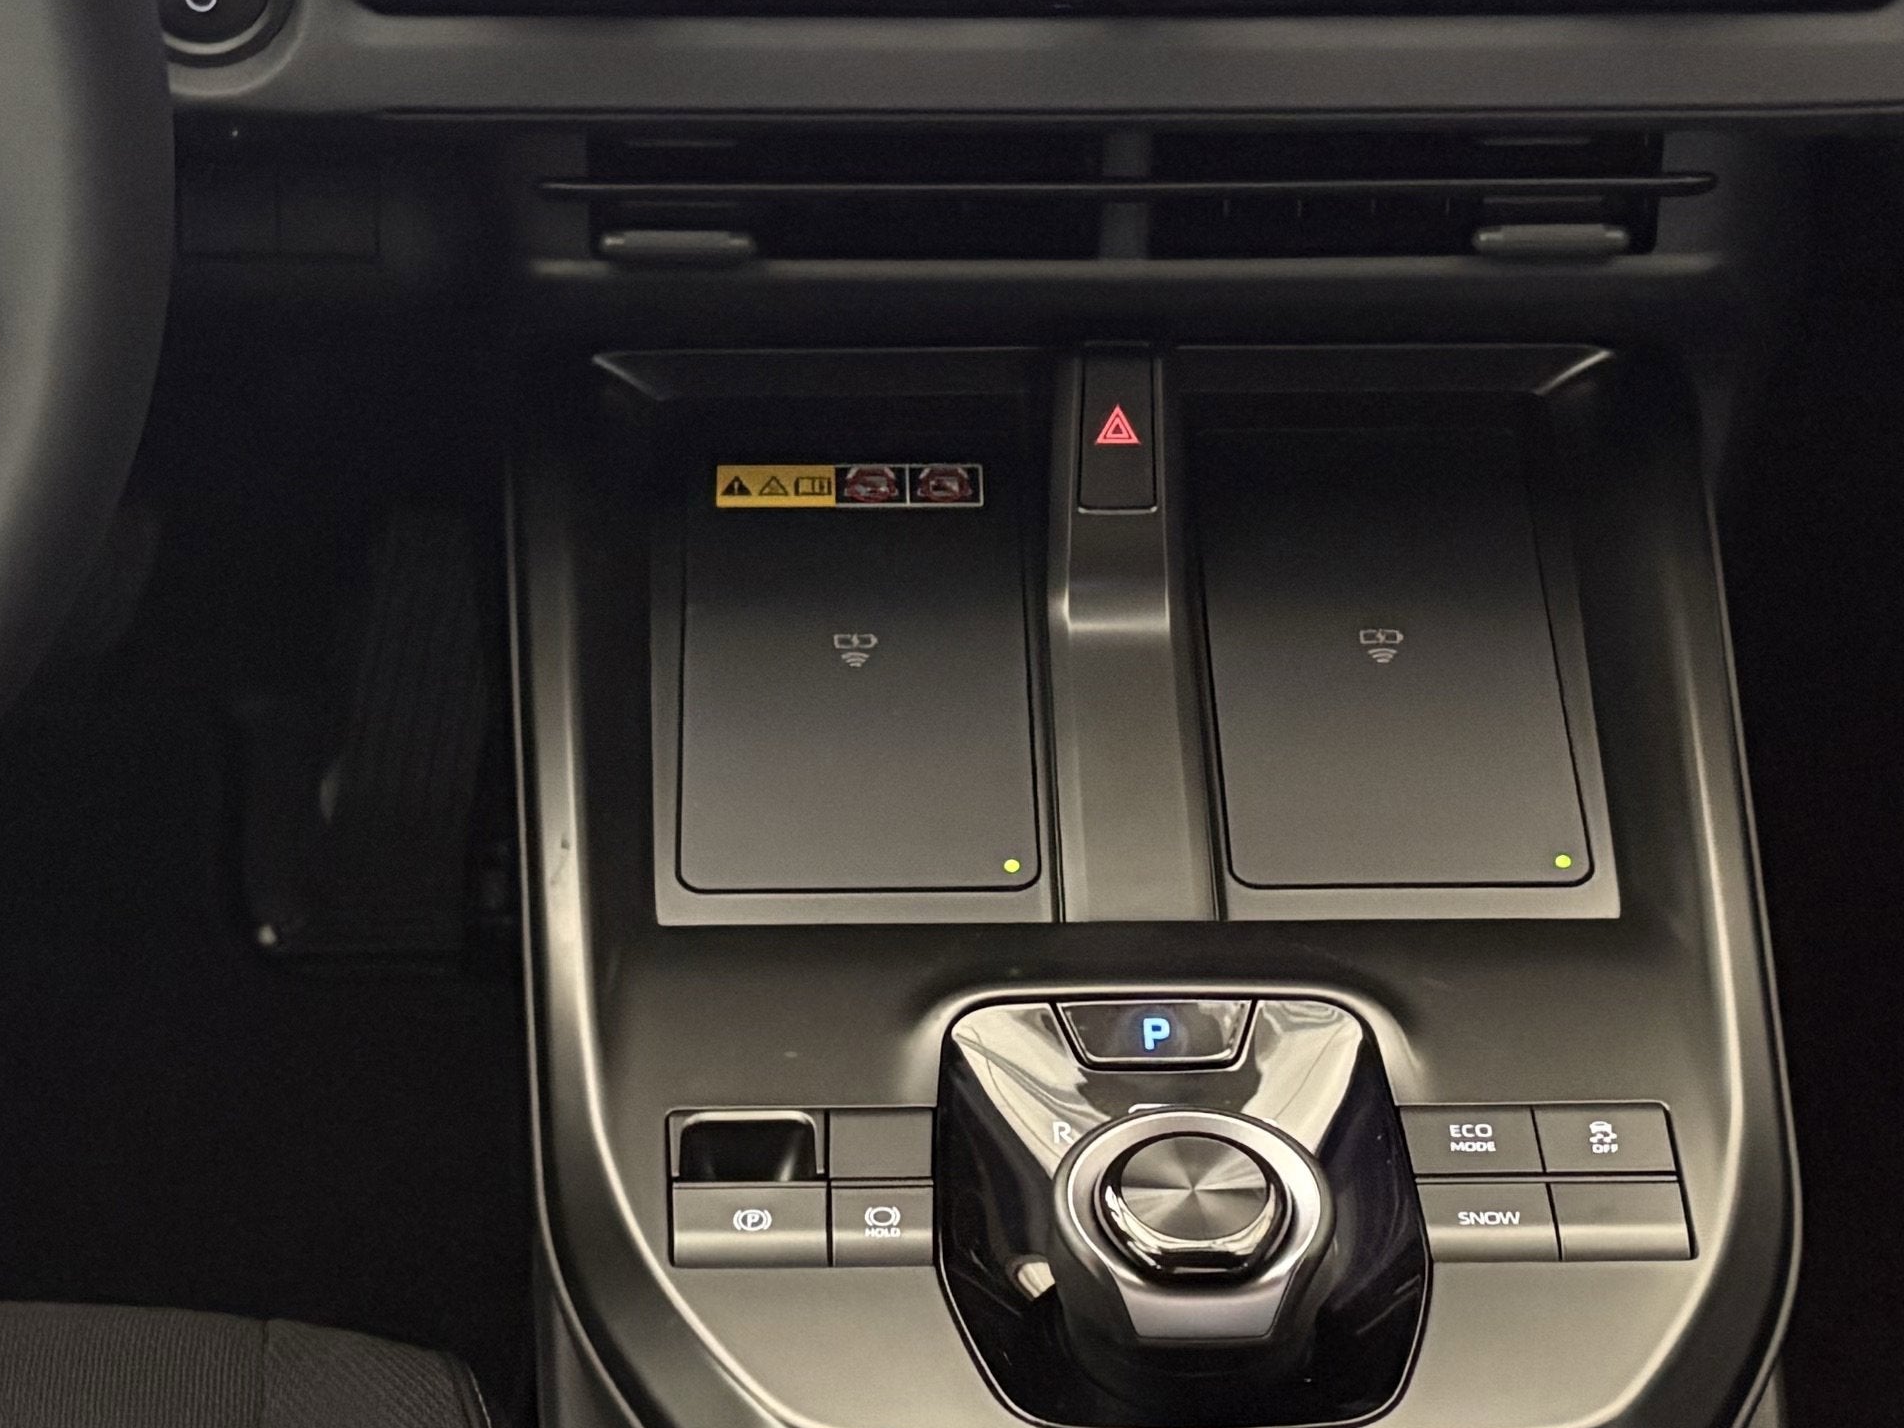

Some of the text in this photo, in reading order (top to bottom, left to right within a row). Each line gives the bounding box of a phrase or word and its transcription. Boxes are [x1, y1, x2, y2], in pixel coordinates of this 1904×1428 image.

[1143, 1017, 1170, 1050] P
[1052, 1121, 1072, 1144] R
[1449, 1124, 1493, 1138] ECO
[1450, 1141, 1496, 1152] MODE
[1592, 1143, 1618, 1153] OFF
[1457, 1211, 1520, 1225] SNOW
[865, 1228, 901, 1238] HOLD
